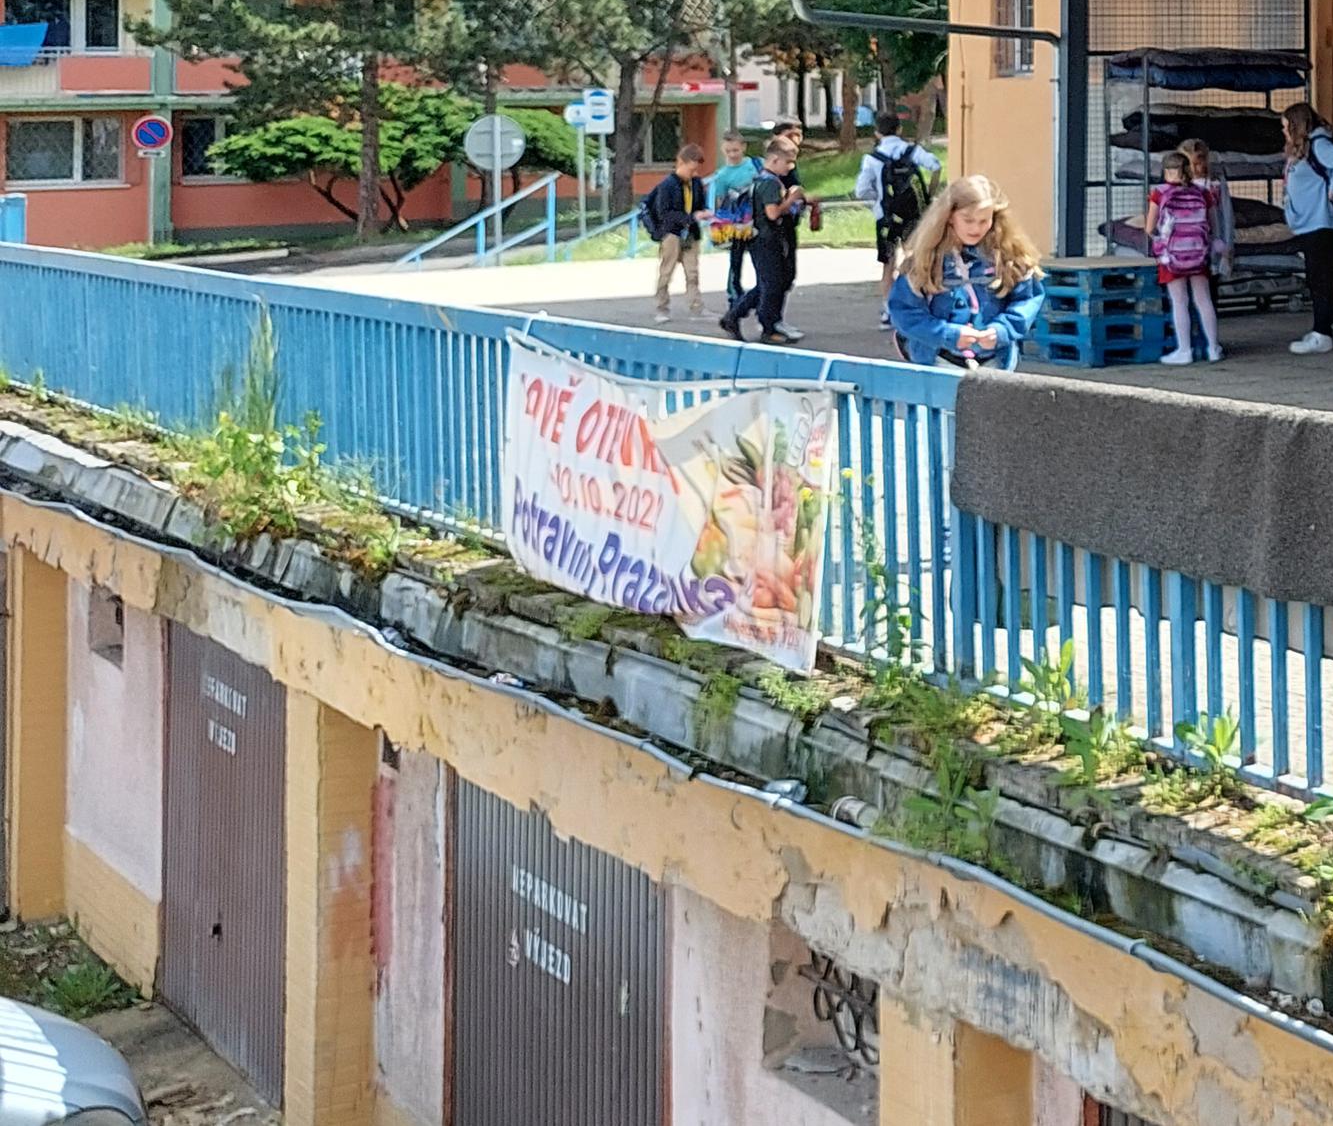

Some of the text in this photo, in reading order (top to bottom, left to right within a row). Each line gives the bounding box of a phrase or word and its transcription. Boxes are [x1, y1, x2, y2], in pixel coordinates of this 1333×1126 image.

[521, 373, 583, 445] OVĚ
[512, 863, 588, 935] NEPARKOVAT
[526, 927, 572, 986] VÝJEZD
